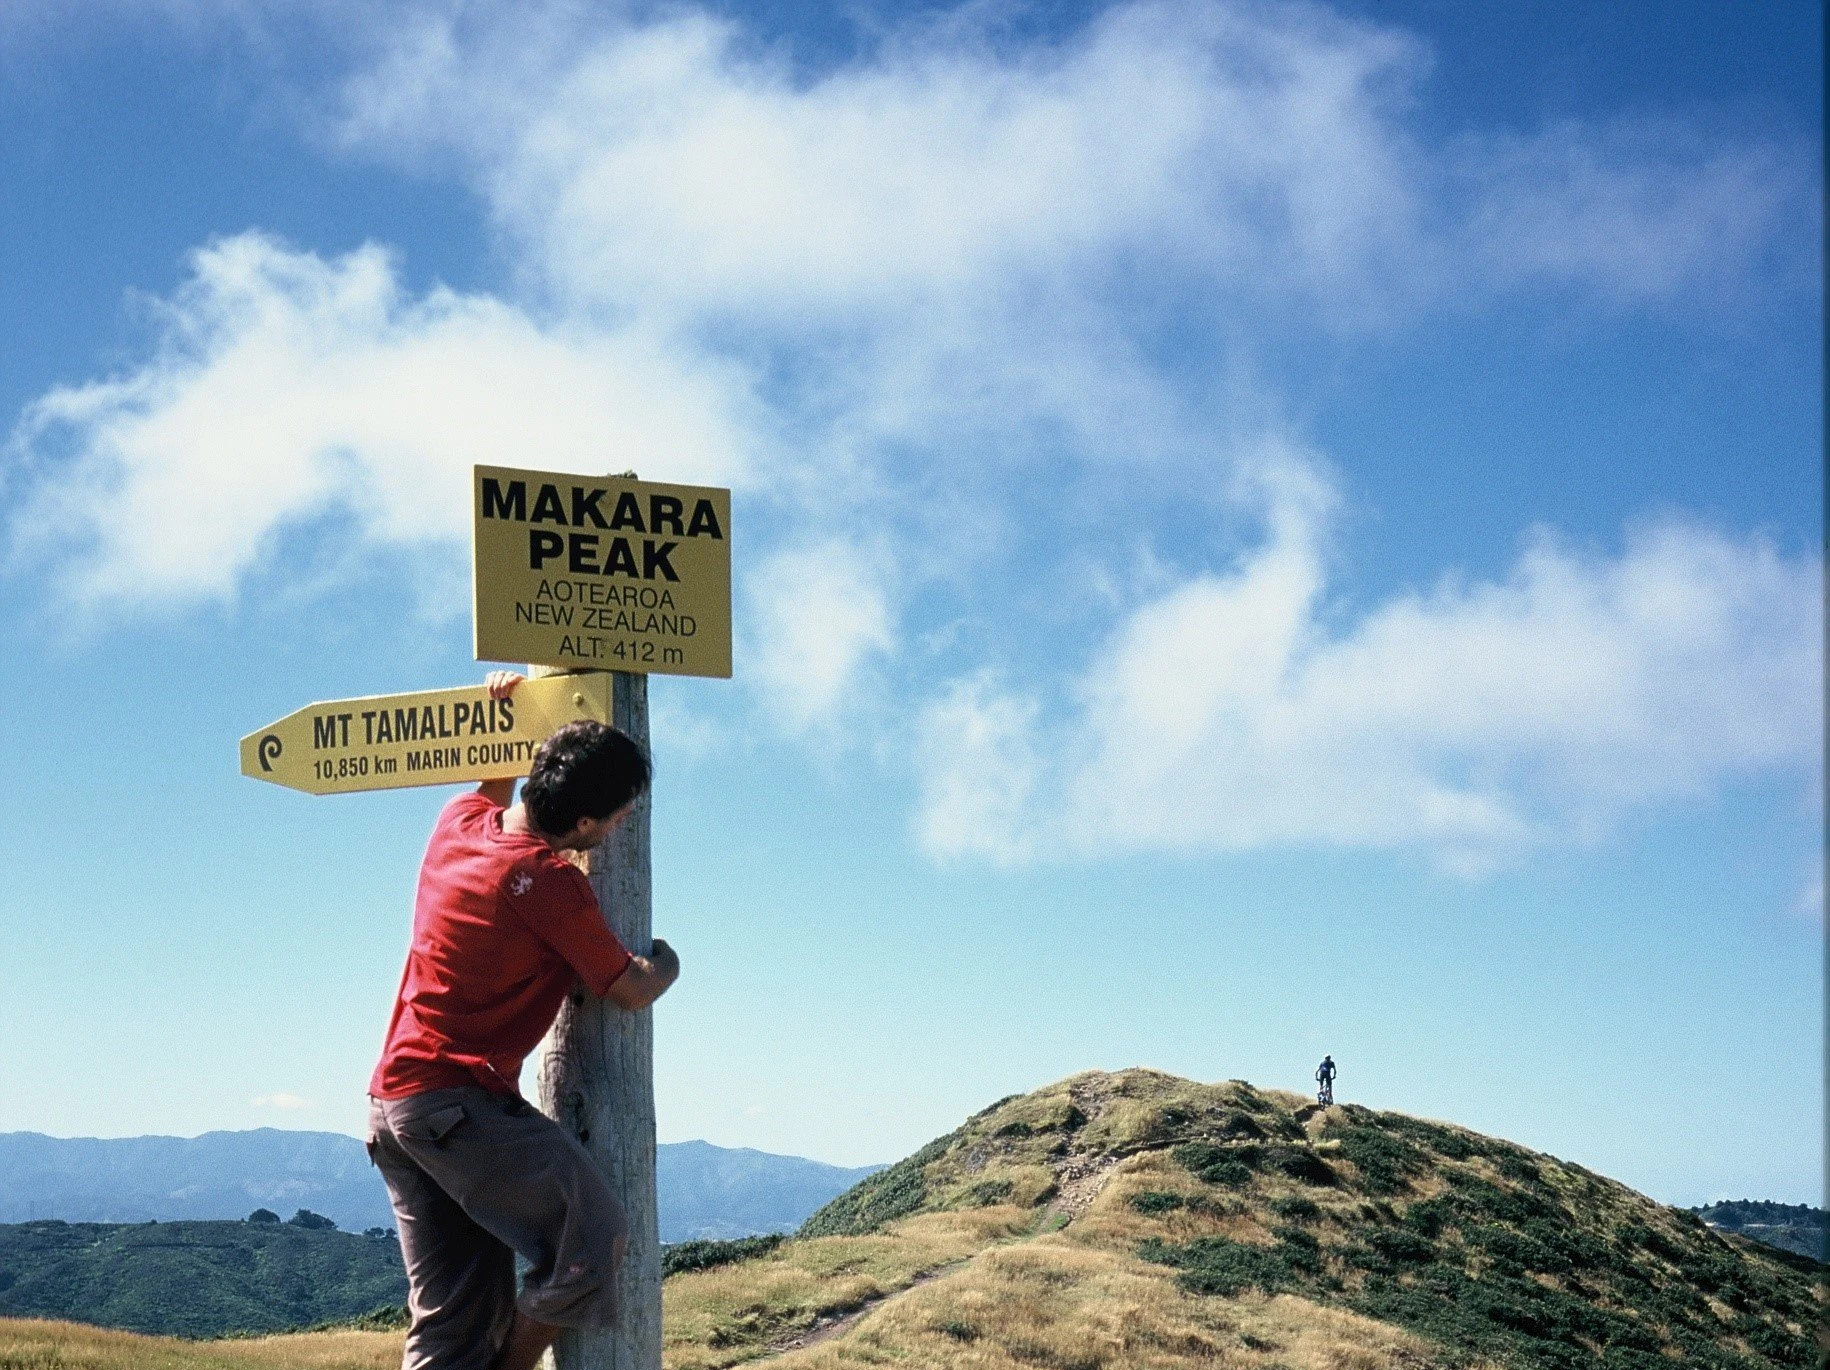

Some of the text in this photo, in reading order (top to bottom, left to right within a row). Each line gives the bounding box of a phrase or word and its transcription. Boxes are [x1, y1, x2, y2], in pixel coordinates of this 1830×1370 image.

[482, 477, 723, 540] MAKARA
[529, 529, 681, 582] PEAK
[536, 579, 675, 610] AOTEAROA
[515, 602, 697, 637] NEW ZEALAND
[558, 635, 684, 664] ALT. 412 m
[313, 697, 515, 749] MT TAMALPAIS
[314, 740, 535, 782] 10,850 km MARIN COUNTY
